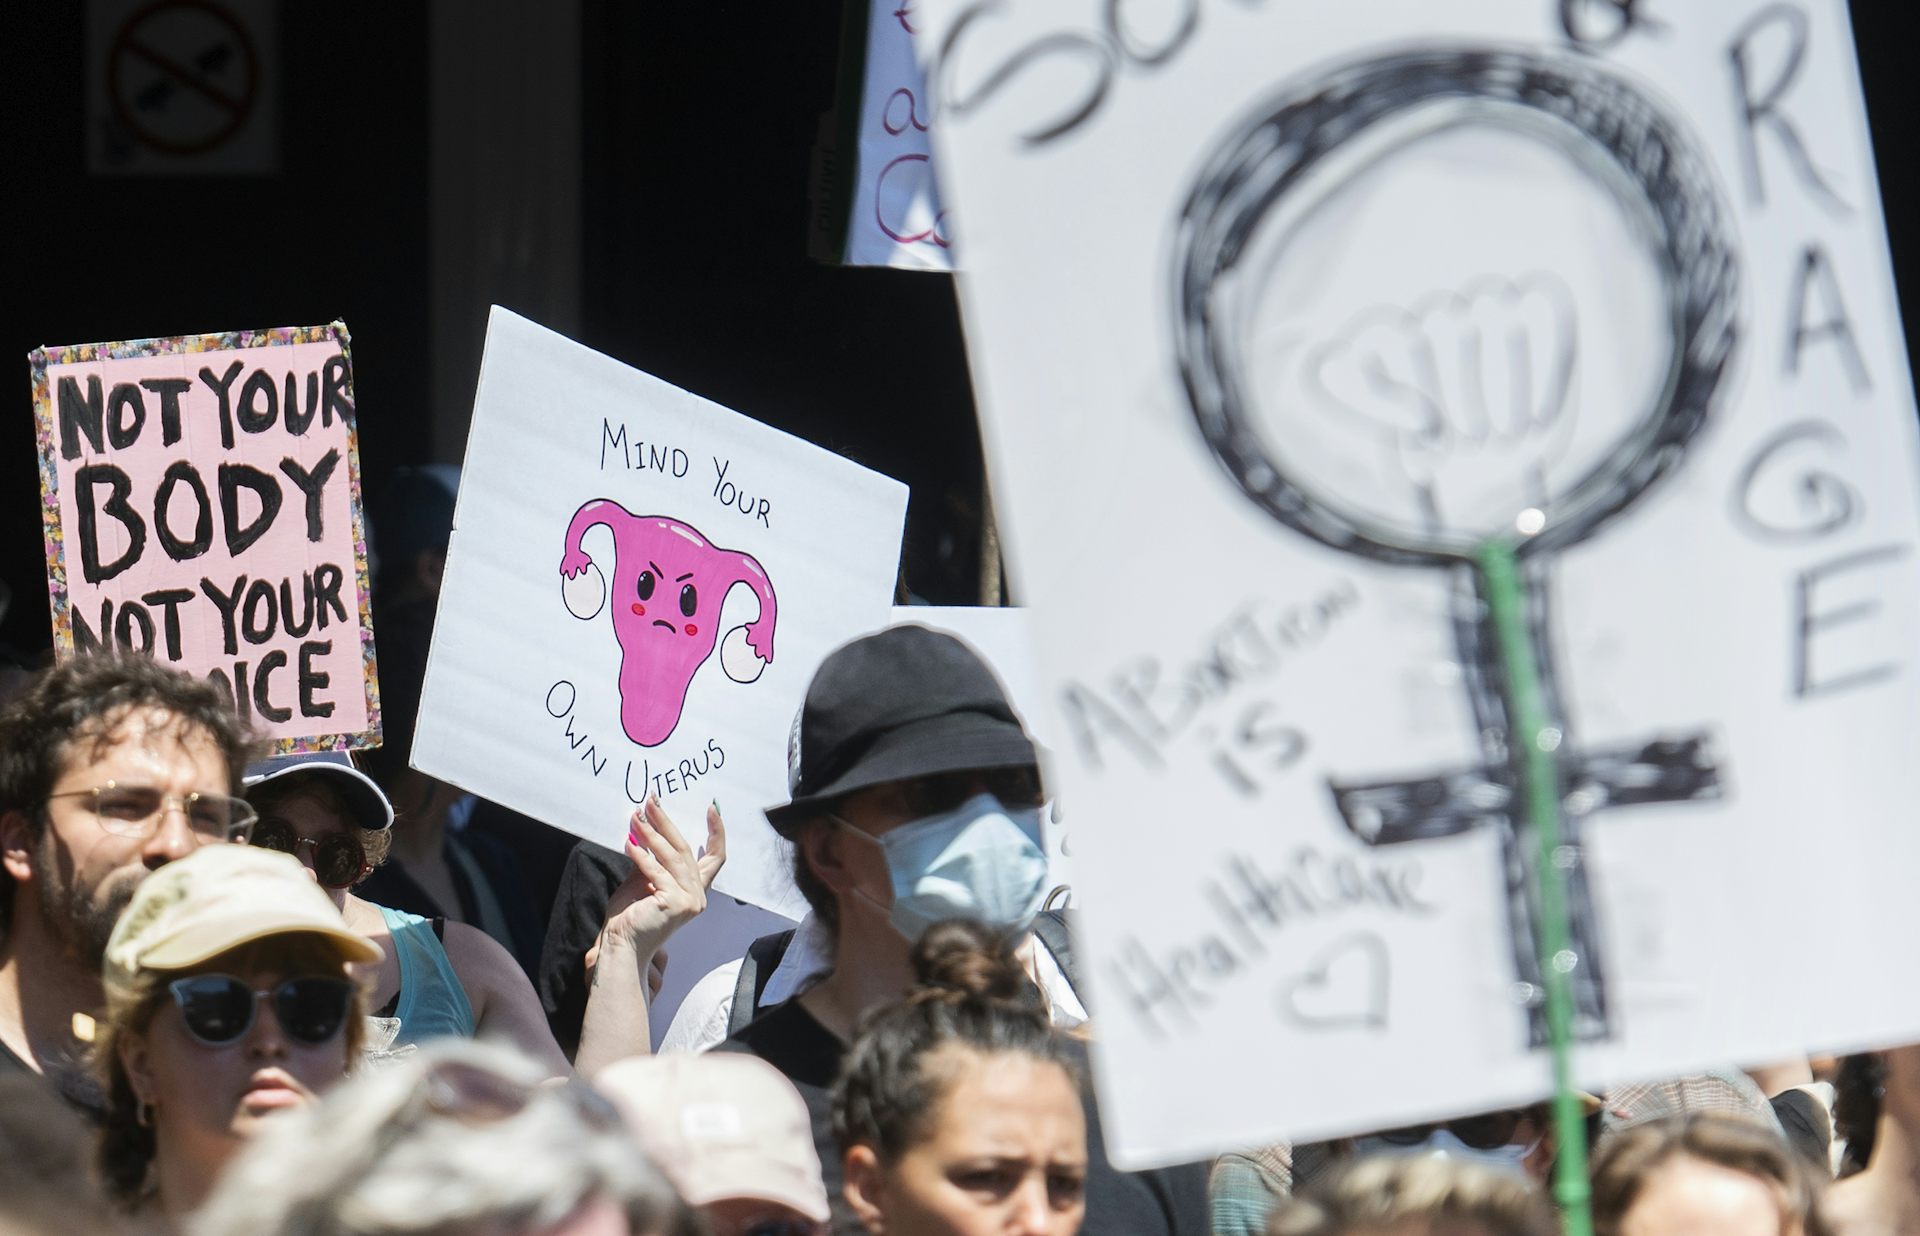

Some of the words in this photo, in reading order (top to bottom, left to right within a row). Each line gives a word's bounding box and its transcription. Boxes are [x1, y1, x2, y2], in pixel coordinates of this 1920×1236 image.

[57, 374, 193, 460] NOT
[199, 353, 355, 450] YOUR
[1725, 2, 1915, 704] RAGE
[75, 448, 342, 588] BODY
[600, 417, 689, 478] MIND
[712, 455, 771, 529] YOUR
[71, 588, 195, 661] NOT
[200, 563, 348, 655] YOUR
[546, 680, 607, 777] OWN
[625, 738, 725, 804] UTERUS
